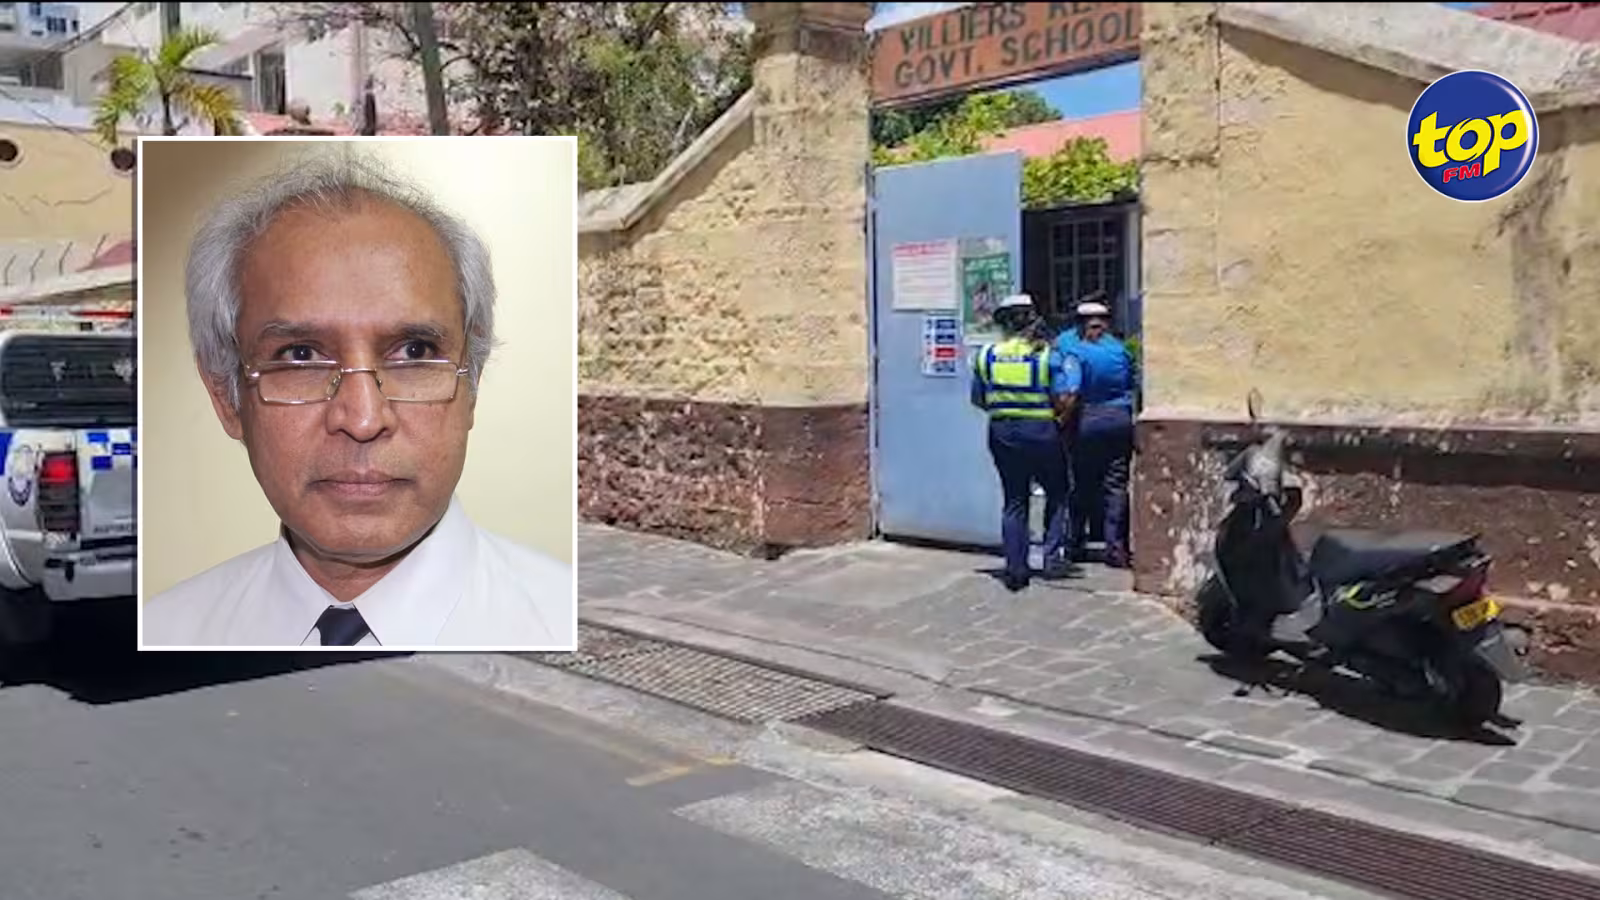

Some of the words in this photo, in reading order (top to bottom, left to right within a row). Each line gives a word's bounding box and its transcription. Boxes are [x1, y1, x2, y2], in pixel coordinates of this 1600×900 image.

[895, 46, 984, 88] GOVT.
[1001, 8, 1140, 66] SCHOOL
[901, 2, 1026, 55] VILLIERS
